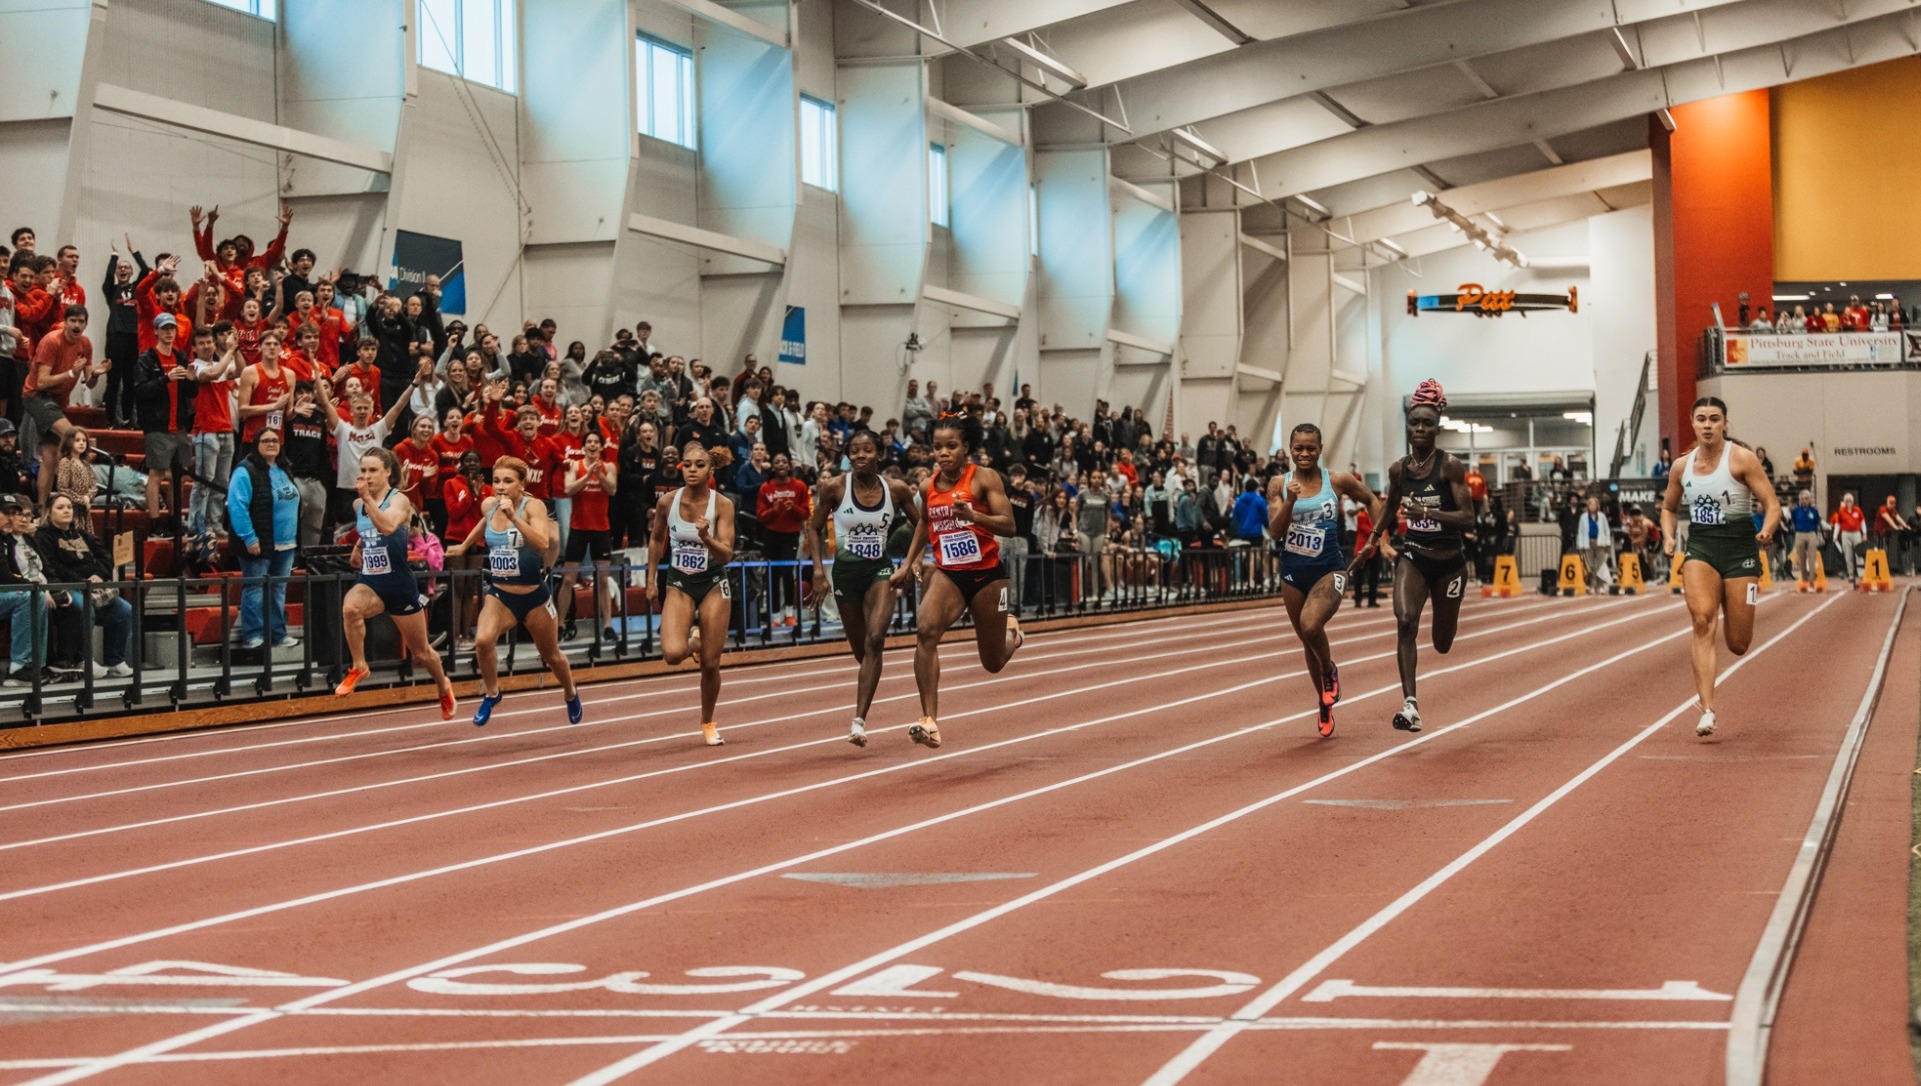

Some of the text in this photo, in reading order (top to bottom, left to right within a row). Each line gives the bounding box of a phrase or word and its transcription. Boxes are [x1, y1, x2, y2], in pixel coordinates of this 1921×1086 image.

[1455, 282, 1516, 313] Pitt
[1750, 337, 1804, 350] Pittsburg
[1806, 336, 1835, 348] State
[1838, 335, 1898, 348] University
[1776, 349, 1845, 360] Track and Field
[293, 429, 322, 439] TRACK
[1834, 447, 1896, 457] RESTROOMS
[1619, 490, 1656, 503] MAKE
[1721, 489, 1731, 506] 1
[1323, 503, 1333, 519] 3
[880, 512, 890, 529] 5
[509, 531, 518, 547] 7
[1287, 531, 1322, 551] 2013
[847, 543, 880, 558] 1848
[943, 539, 977, 559] 1586
[364, 554, 388, 569] 1999
[490, 556, 517, 570] 2003
[675, 553, 706, 570] 1862
[1871, 558, 1880, 577] 1
[1501, 565, 1511, 583] 7
[1565, 563, 1576, 581] 6
[1631, 562, 1640, 580] 5
[722, 581, 730, 597] 6
[1335, 575, 1343, 591] 3
[1448, 580, 1459, 596] 2
[999, 591, 1007, 610] 4
[1750, 585, 1757, 604] 1
